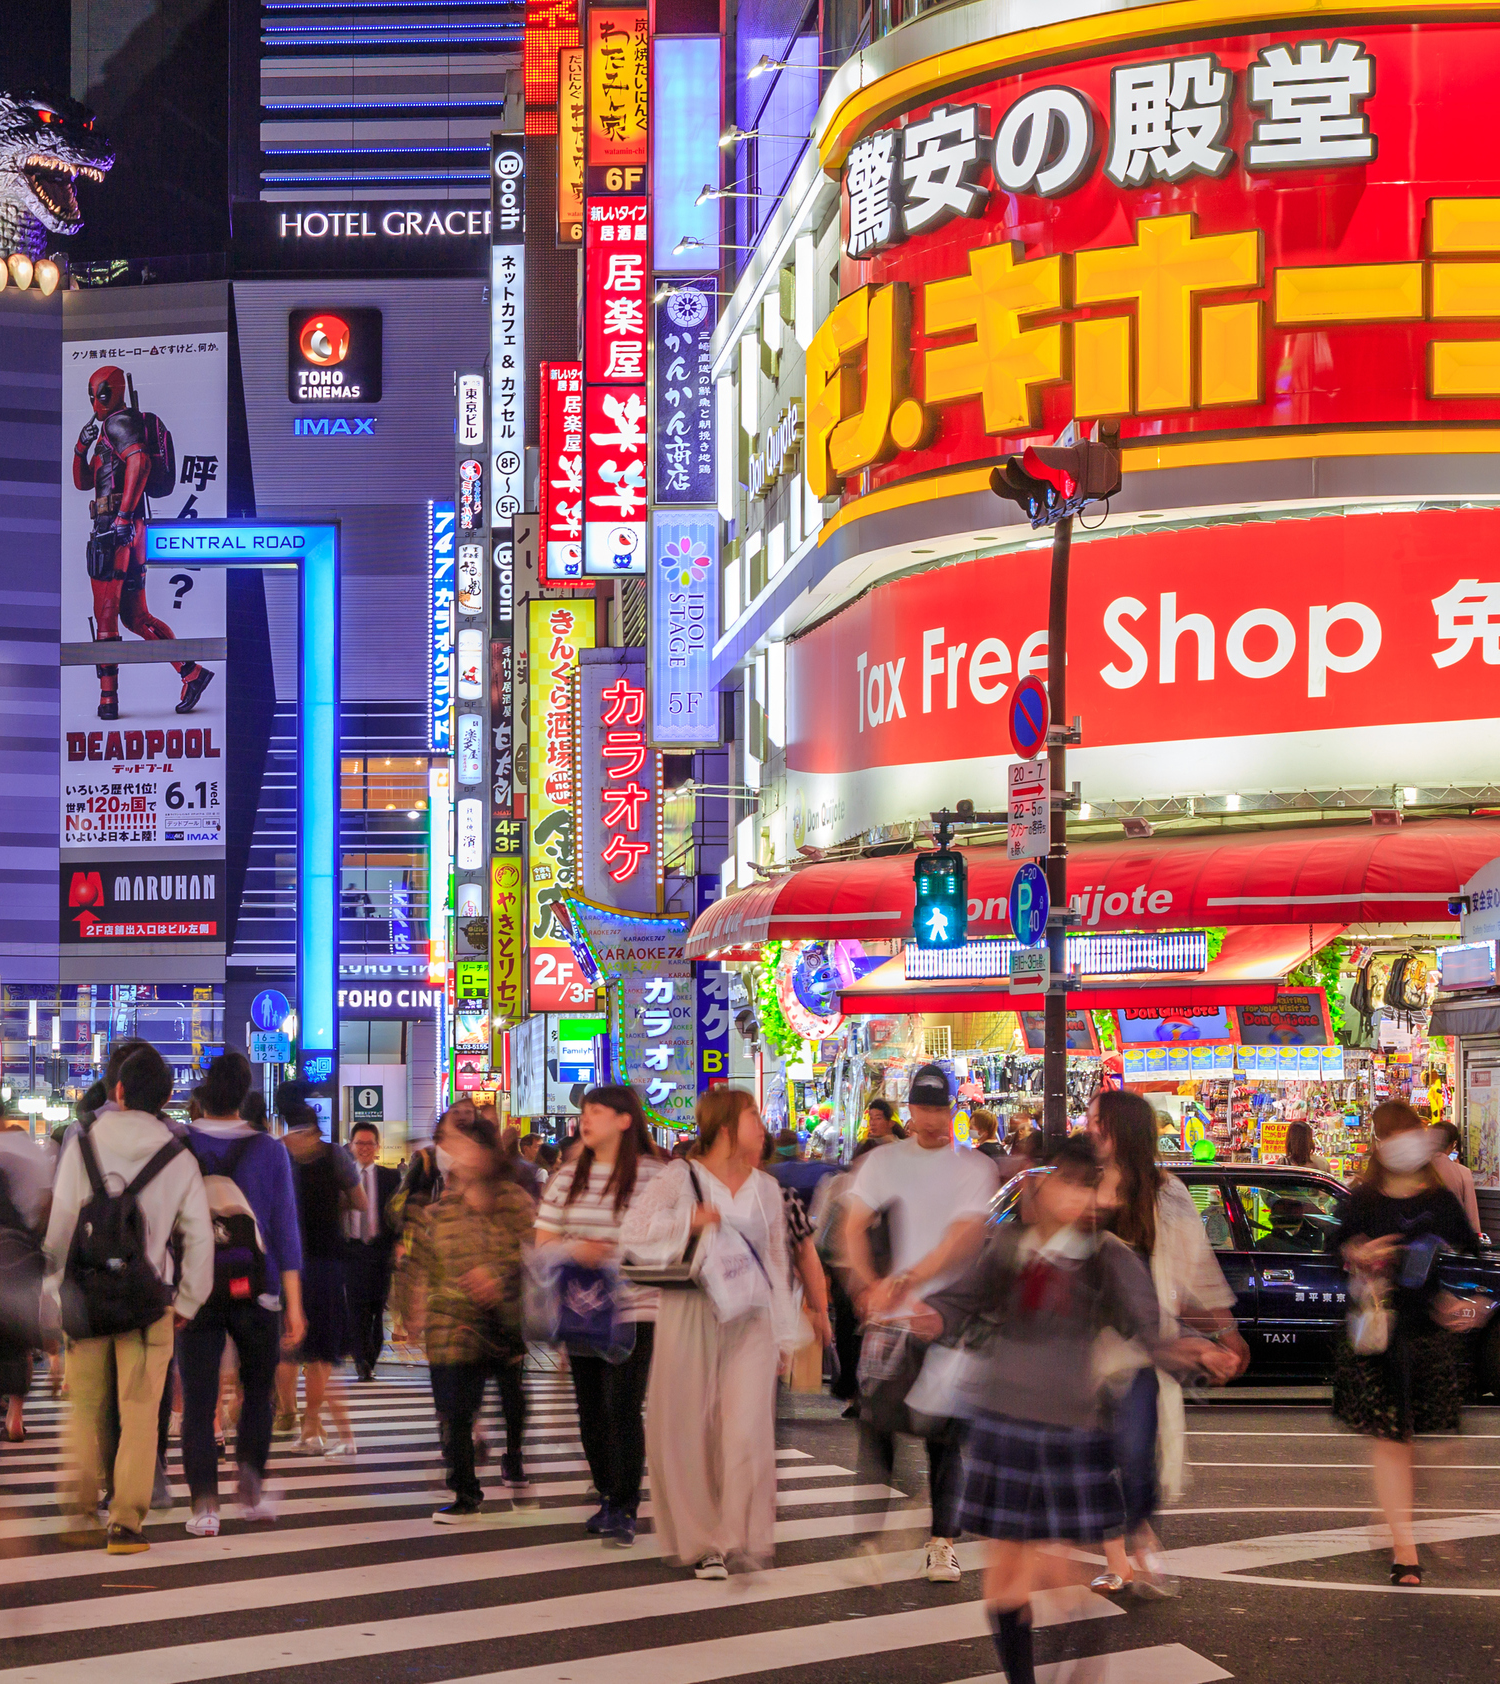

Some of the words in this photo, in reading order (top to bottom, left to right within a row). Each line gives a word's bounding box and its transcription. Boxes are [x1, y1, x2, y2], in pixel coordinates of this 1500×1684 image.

[846, 38, 1377, 260] 驚安の殿堂
[606, 168, 643, 191] 6F
[280, 212, 376, 237] HOTEL
[591, 205, 646, 222] 新しいタイプ
[600, 225, 646, 242] 居酒屋
[603, 254, 644, 379] 居楽屋
[299, 371, 344, 385] TOHO
[299, 386, 360, 398] CINEMAS
[465, 388, 477, 439] 東京ビル
[665, 332, 692, 491] かんかん商店
[294, 417, 375, 436] IMAX
[563, 395, 581, 453] 居楽屋
[501, 457, 516, 469] 8F
[501, 501, 516, 513] 5F
[155, 535, 246, 549] CENTRAL
[254, 534, 306, 549] ROAD
[433, 511, 456, 580] 747
[669, 592, 686, 668] STAGE
[687, 592, 705, 654] IDOL
[857, 651, 907, 733] Tax
[922, 627, 1068, 714] Free
[1100, 591, 1382, 698] Shop
[501, 646, 511, 717] 手作り居酒屋
[669, 692, 703, 714] 5F
[66, 728, 221, 762] DEADPOOL
[112, 763, 174, 774] デッドプール
[66, 782, 157, 796] いろいろ歴代1位!
[601, 678, 650, 883] カラオケ
[165, 781, 207, 810] 6.1
[66, 831, 157, 843] いよいよ日本上陸!
[187, 833, 219, 841] IMAX
[495, 820, 520, 836] 4F
[495, 836, 520, 853] 3F
[114, 874, 216, 901] MARUHAN
[1017, 882, 1033, 935] P
[1029, 909, 1040, 933] 40
[86, 924, 209, 936] 2F店舗出入口はビル左側
[534, 953, 574, 984] 2F
[338, 990, 396, 1008] TOHO
[644, 977, 677, 1105] カラオケ
[1263, 1333, 1296, 1343] TAXI
